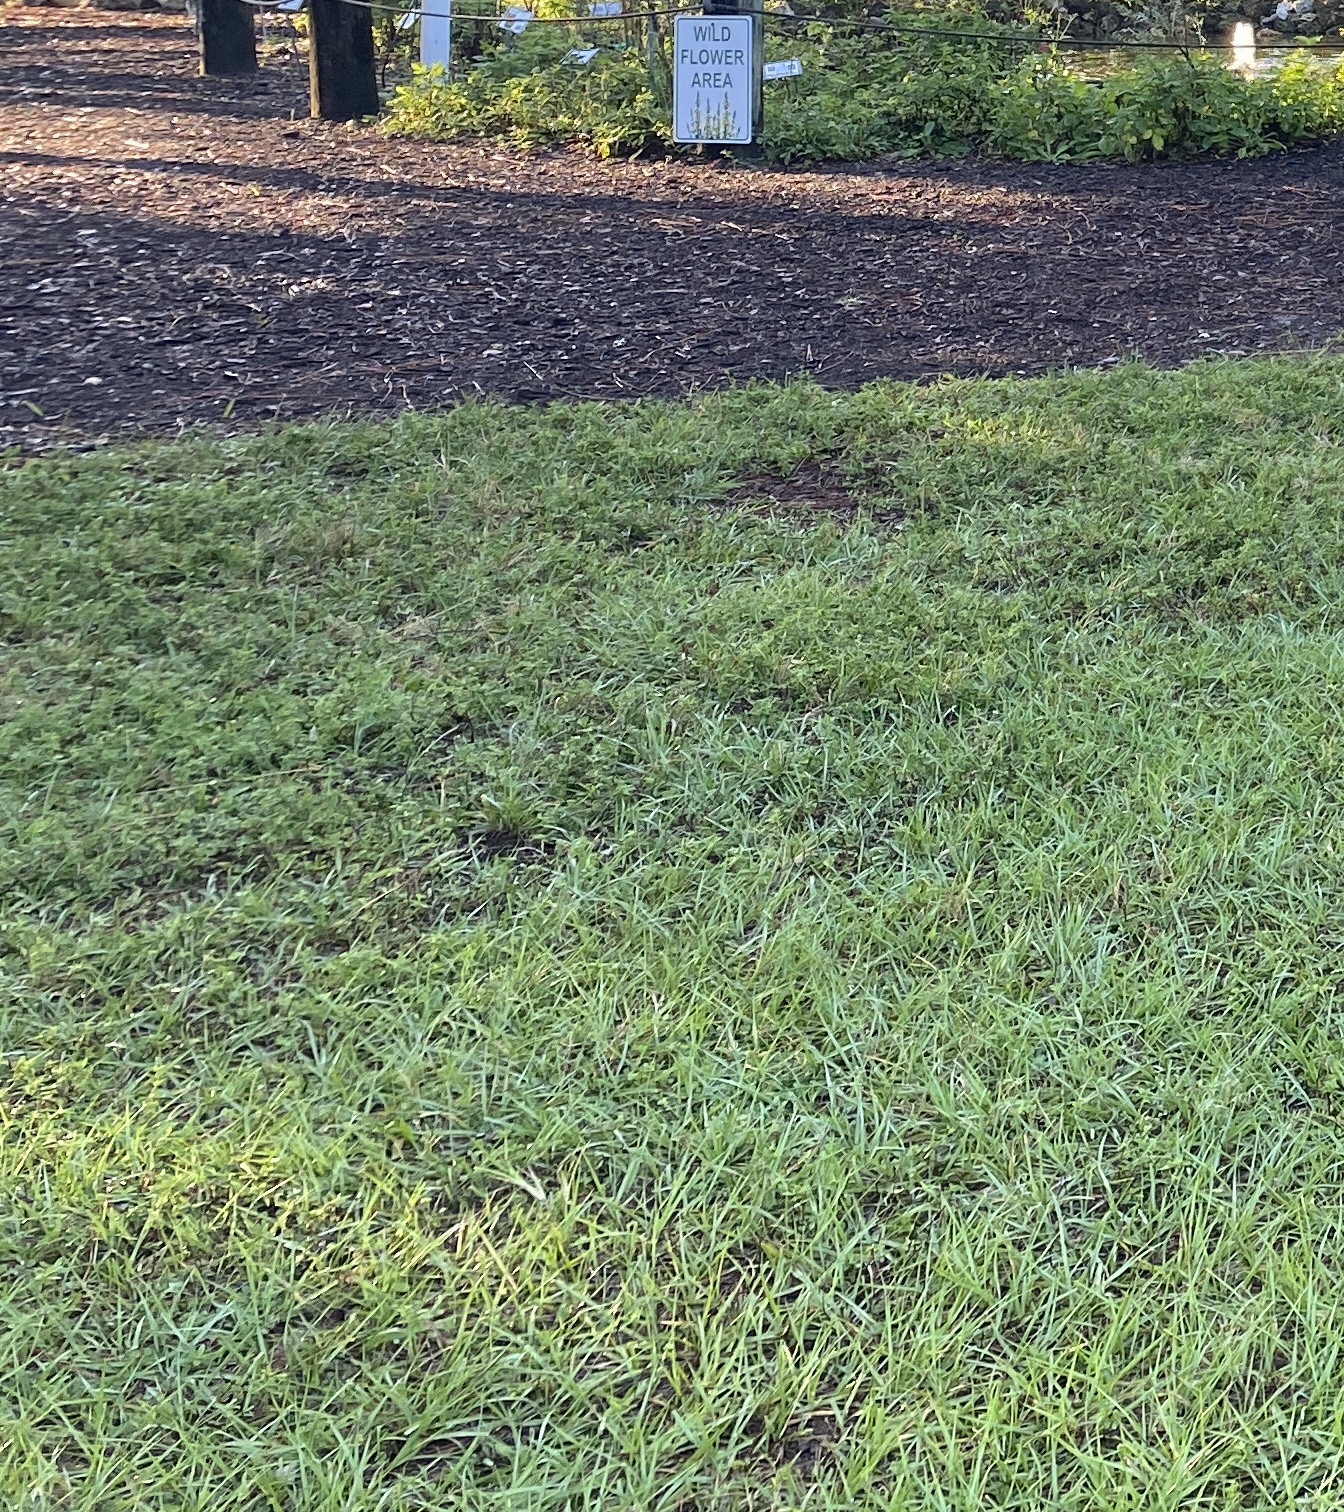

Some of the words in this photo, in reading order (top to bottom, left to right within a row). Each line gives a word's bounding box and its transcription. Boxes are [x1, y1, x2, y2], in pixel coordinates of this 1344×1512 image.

[693, 26, 731, 41] WILD
[681, 49, 744, 65] FLOWER
[691, 72, 733, 88] AREA
